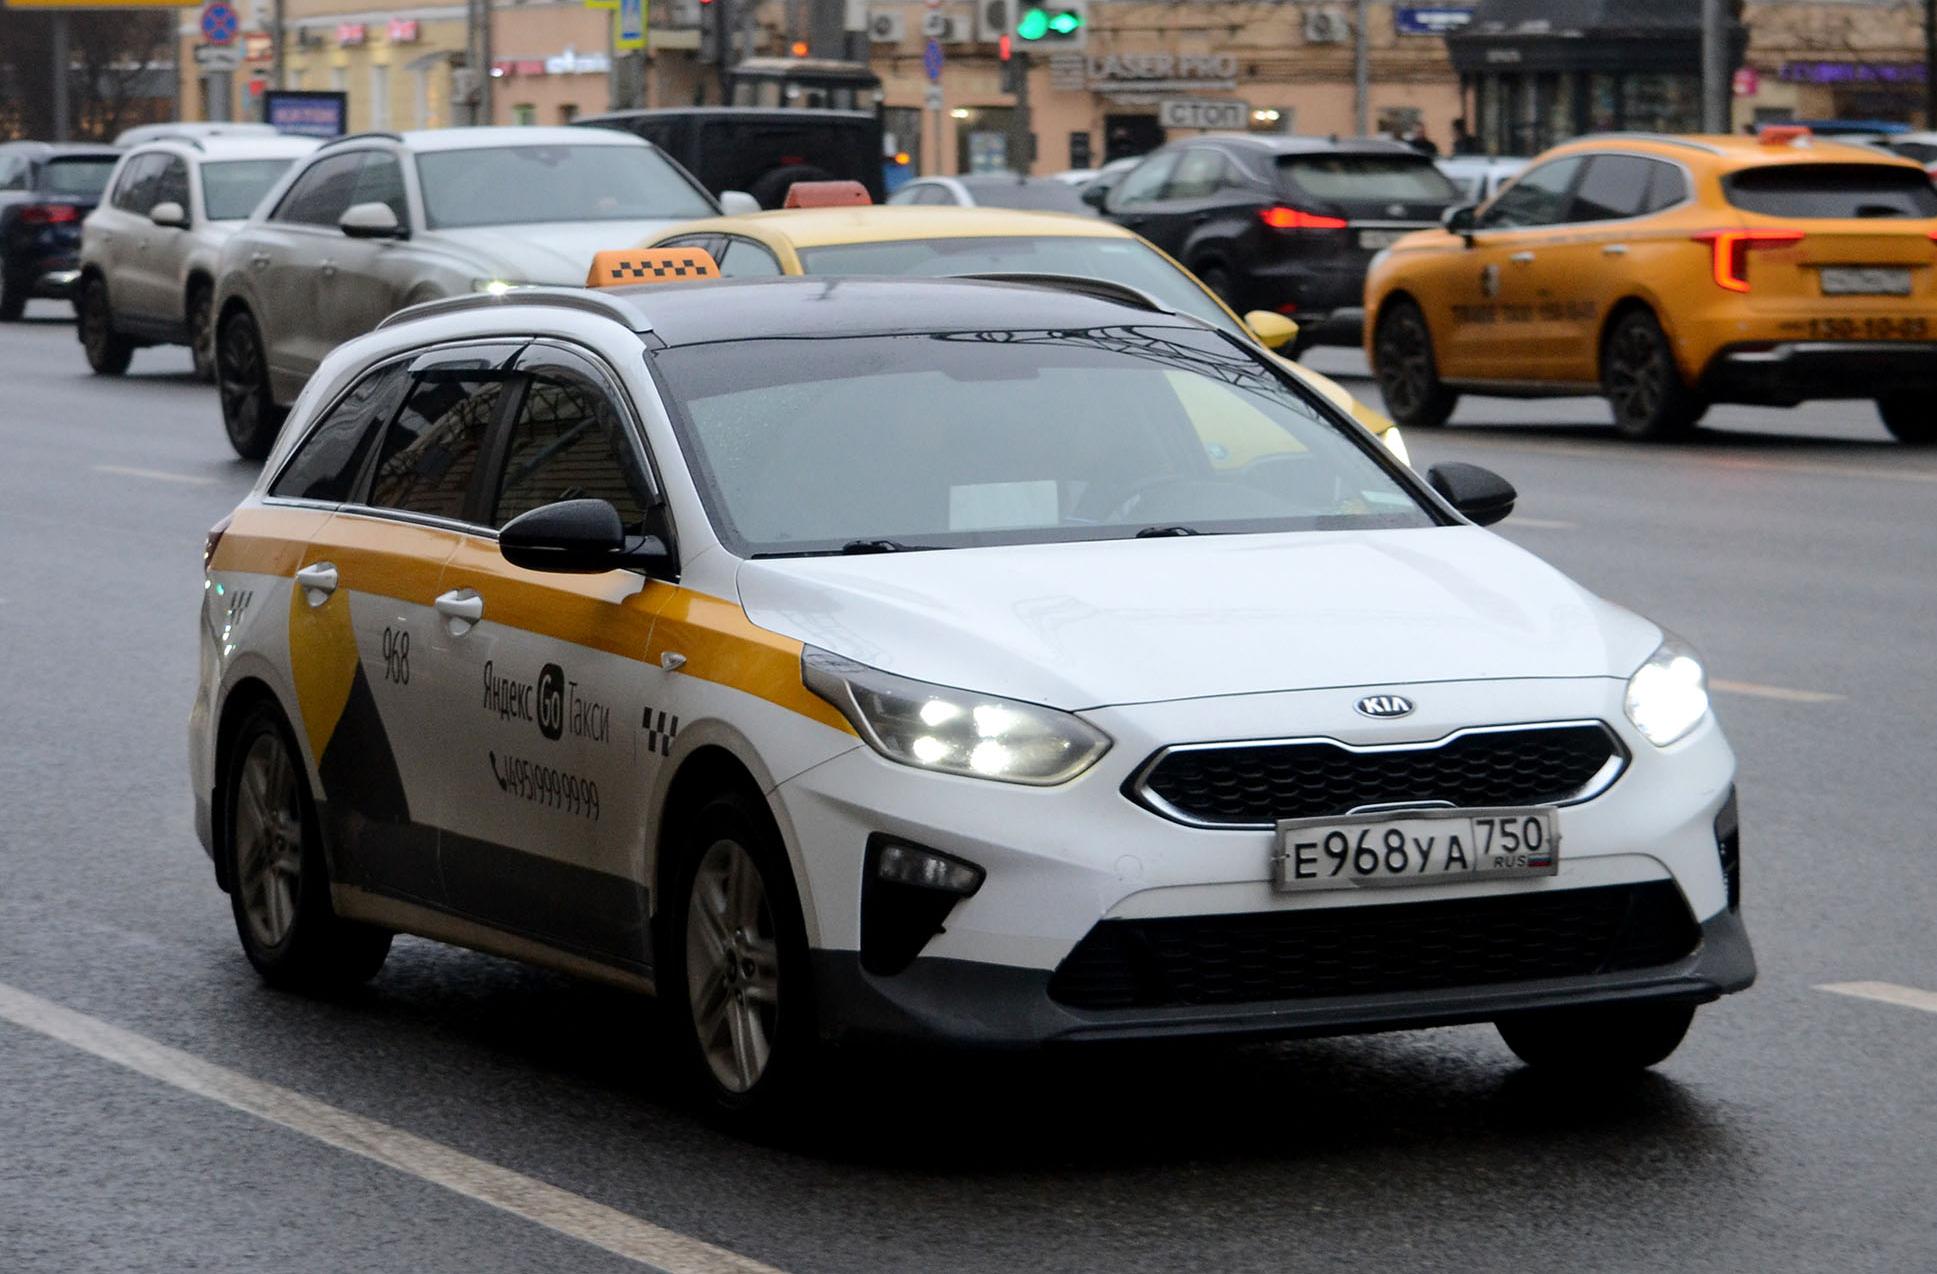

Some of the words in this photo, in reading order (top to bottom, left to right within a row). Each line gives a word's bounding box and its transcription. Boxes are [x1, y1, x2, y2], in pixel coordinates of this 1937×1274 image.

[1088, 54, 1174, 79] LASER
[1180, 54, 1238, 78] PRO
[1168, 104, 1241, 124] СТОП
[383, 626, 410, 686] 968
[483, 660, 534, 722] Яндекс
[540, 671, 562, 732] Go
[568, 680, 610, 744] Такси
[1363, 697, 1410, 714] KIA
[1294, 828, 1468, 879] Е968УА
[1475, 816, 1543, 855] 750
[1493, 856, 1527, 869] RUS
